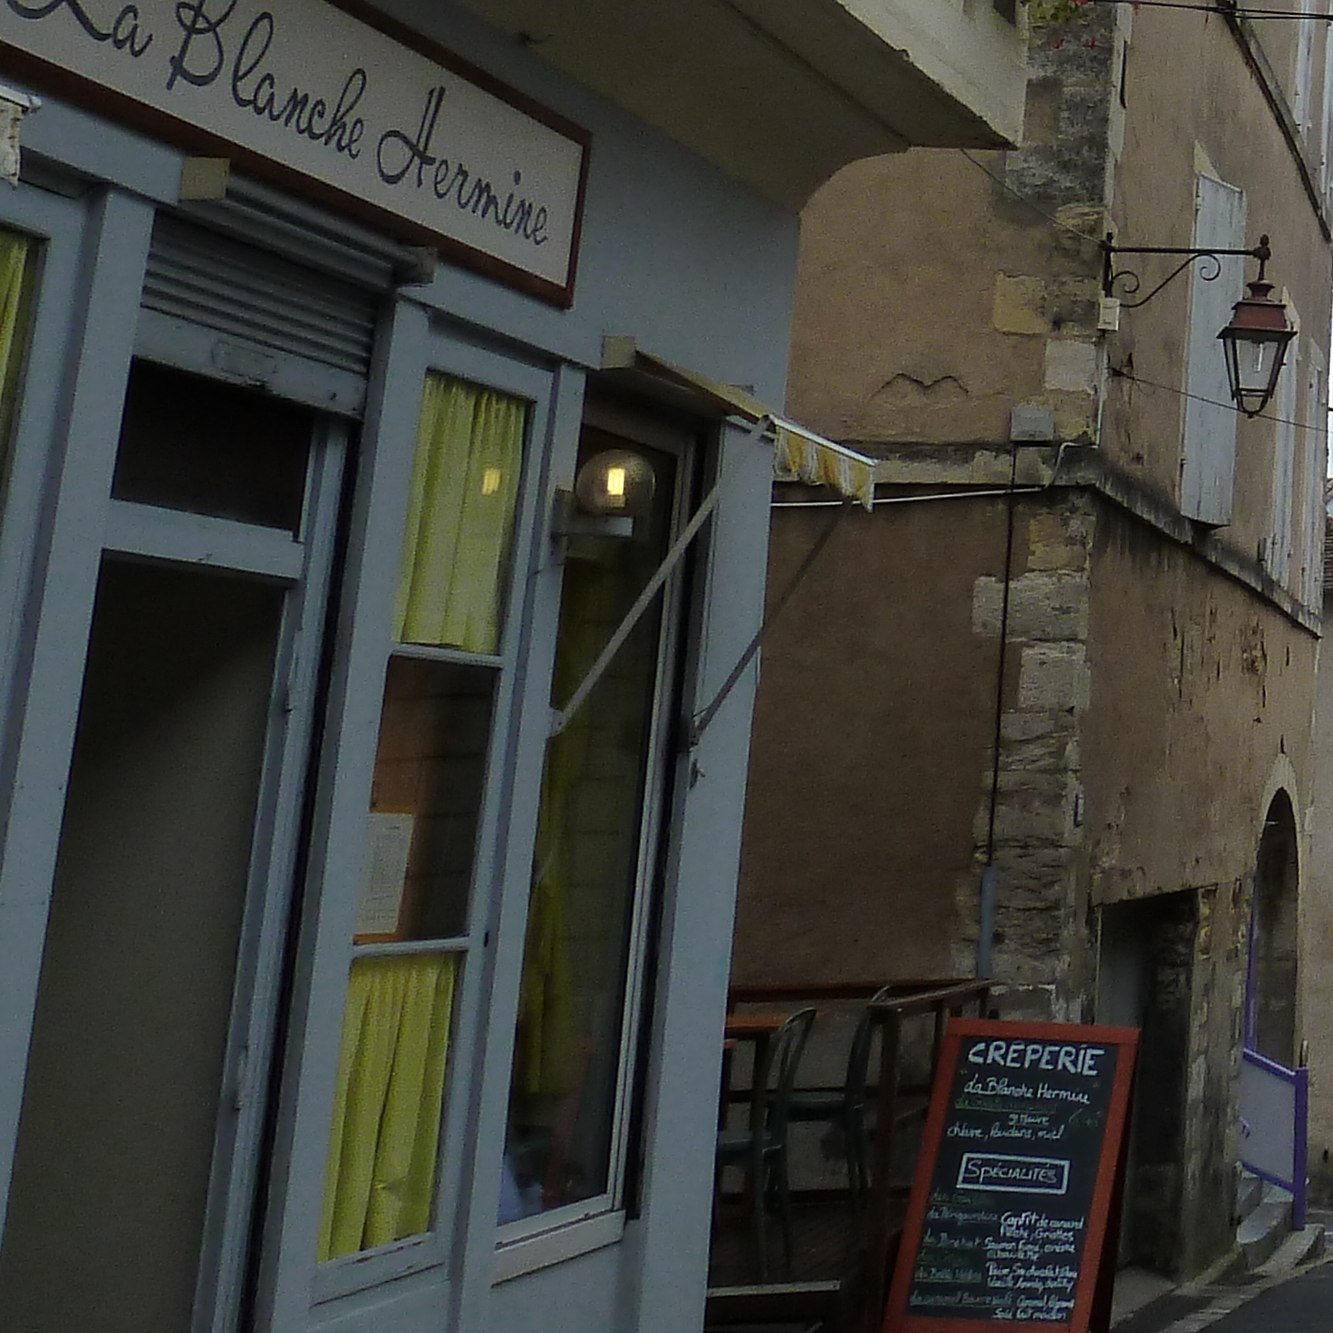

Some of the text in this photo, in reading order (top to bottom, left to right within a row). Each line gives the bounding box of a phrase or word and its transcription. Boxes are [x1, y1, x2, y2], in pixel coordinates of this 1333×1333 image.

[377, 86, 549, 246] Hermine
[985, 1076, 1034, 1098] Blanche
[1037, 1082, 1091, 1104] Hermine
